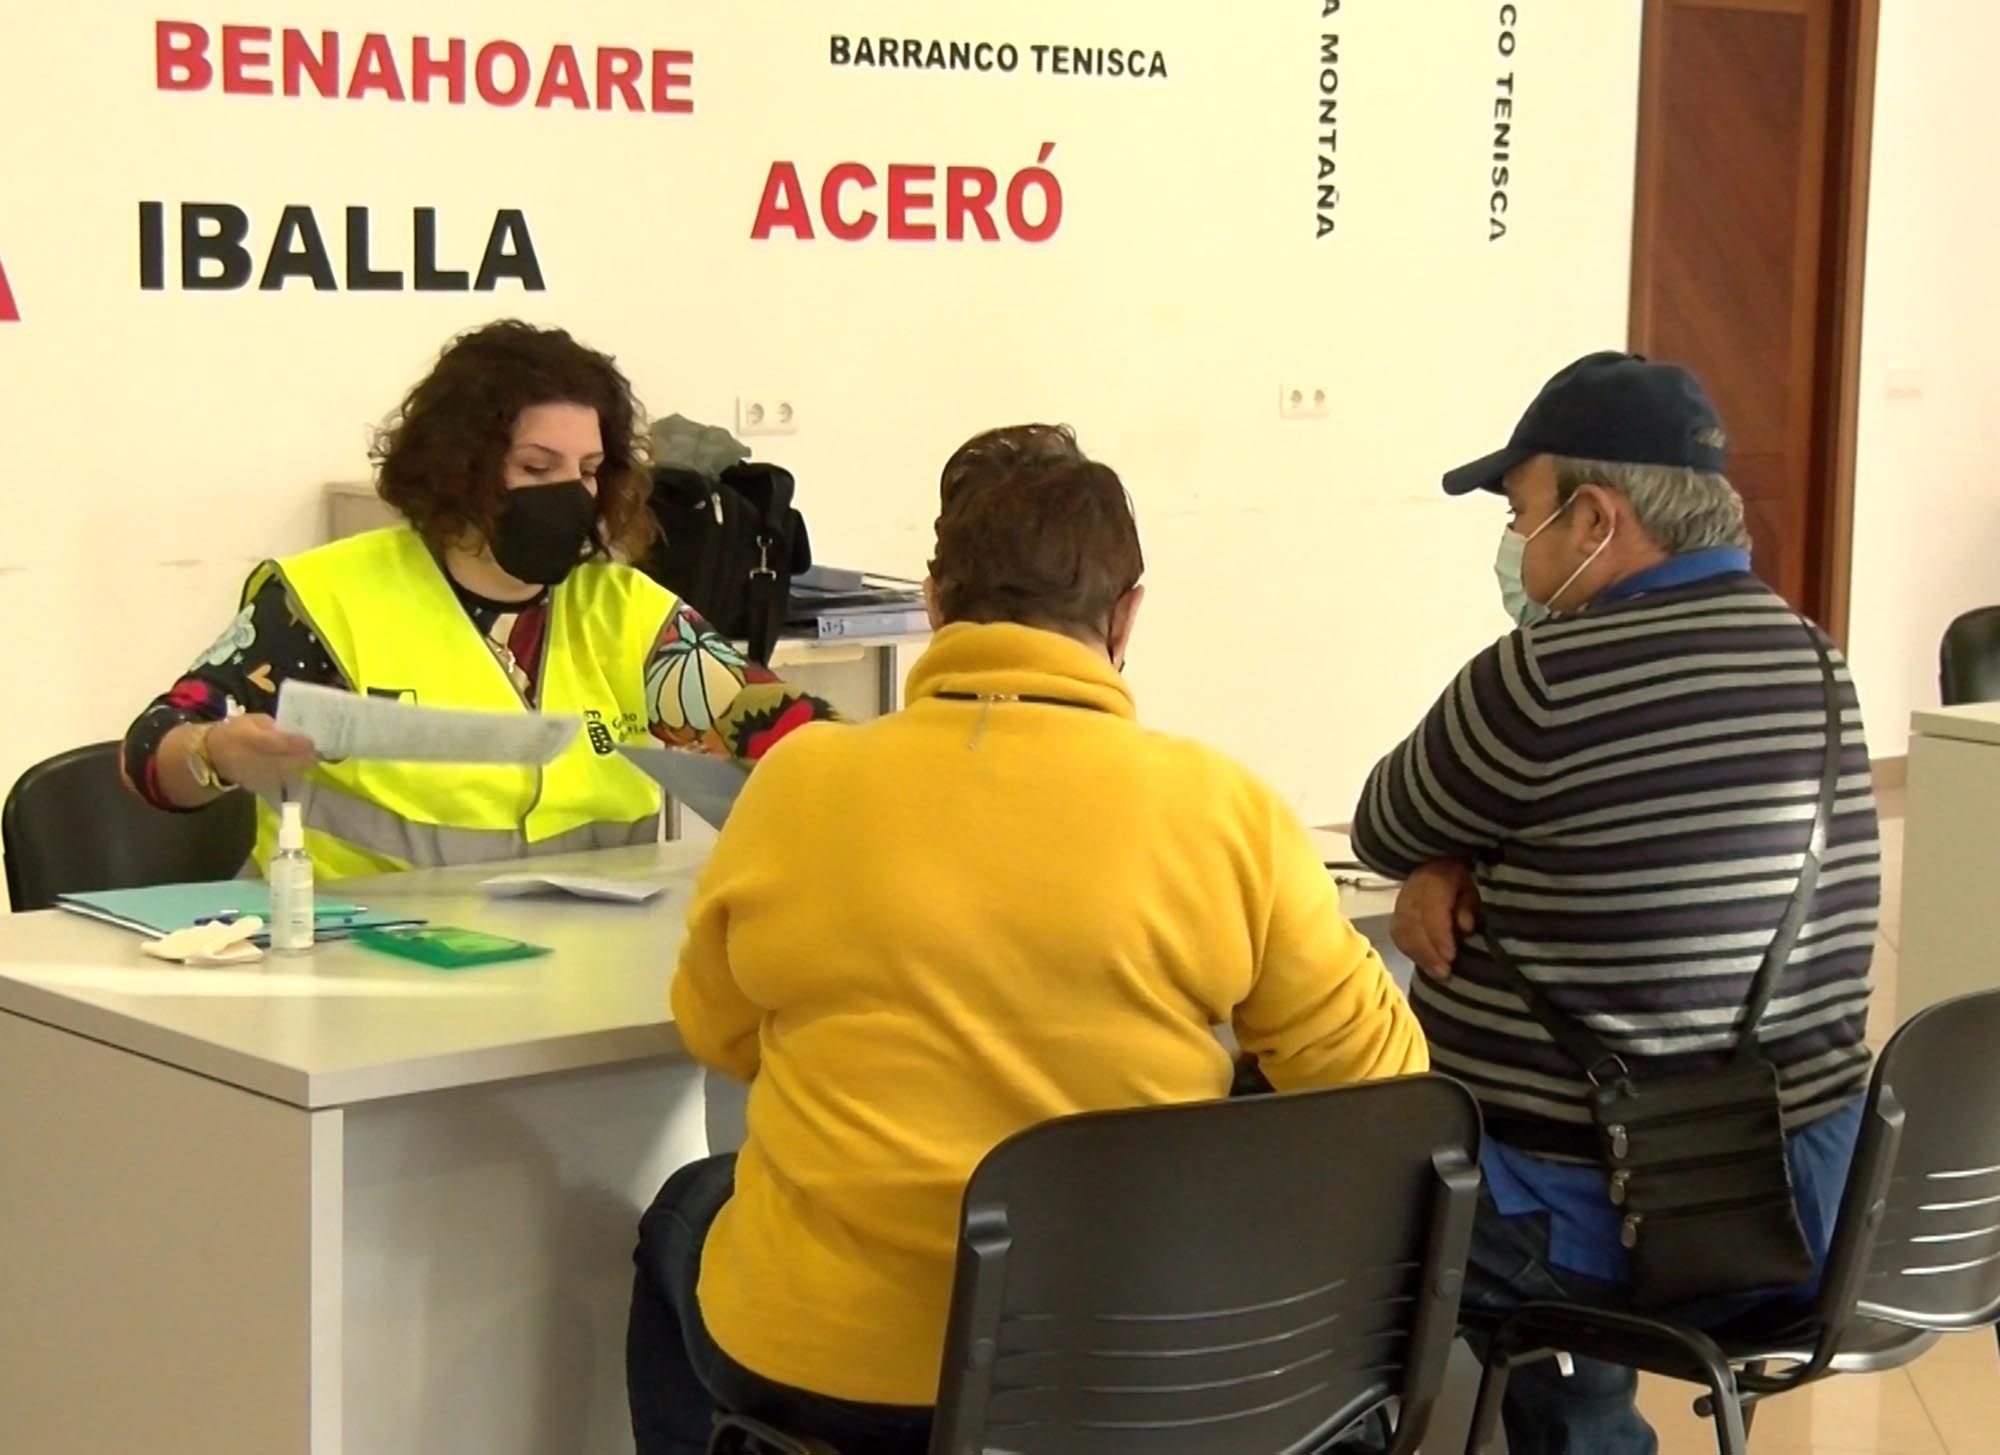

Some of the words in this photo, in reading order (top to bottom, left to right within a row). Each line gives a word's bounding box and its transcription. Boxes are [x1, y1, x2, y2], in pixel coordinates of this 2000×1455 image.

[155, 20, 694, 113] BENAHOARE
[830, 34, 1018, 72] BARRANCO
[1030, 44, 1167, 78] TENISCA
[1498, 4, 1517, 57] CO
[1316, 34, 1339, 239] MONTAÑA
[1489, 72, 1514, 241] TENISCA
[750, 142, 1062, 242] ACERÓ
[138, 201, 546, 291] IBALLA
